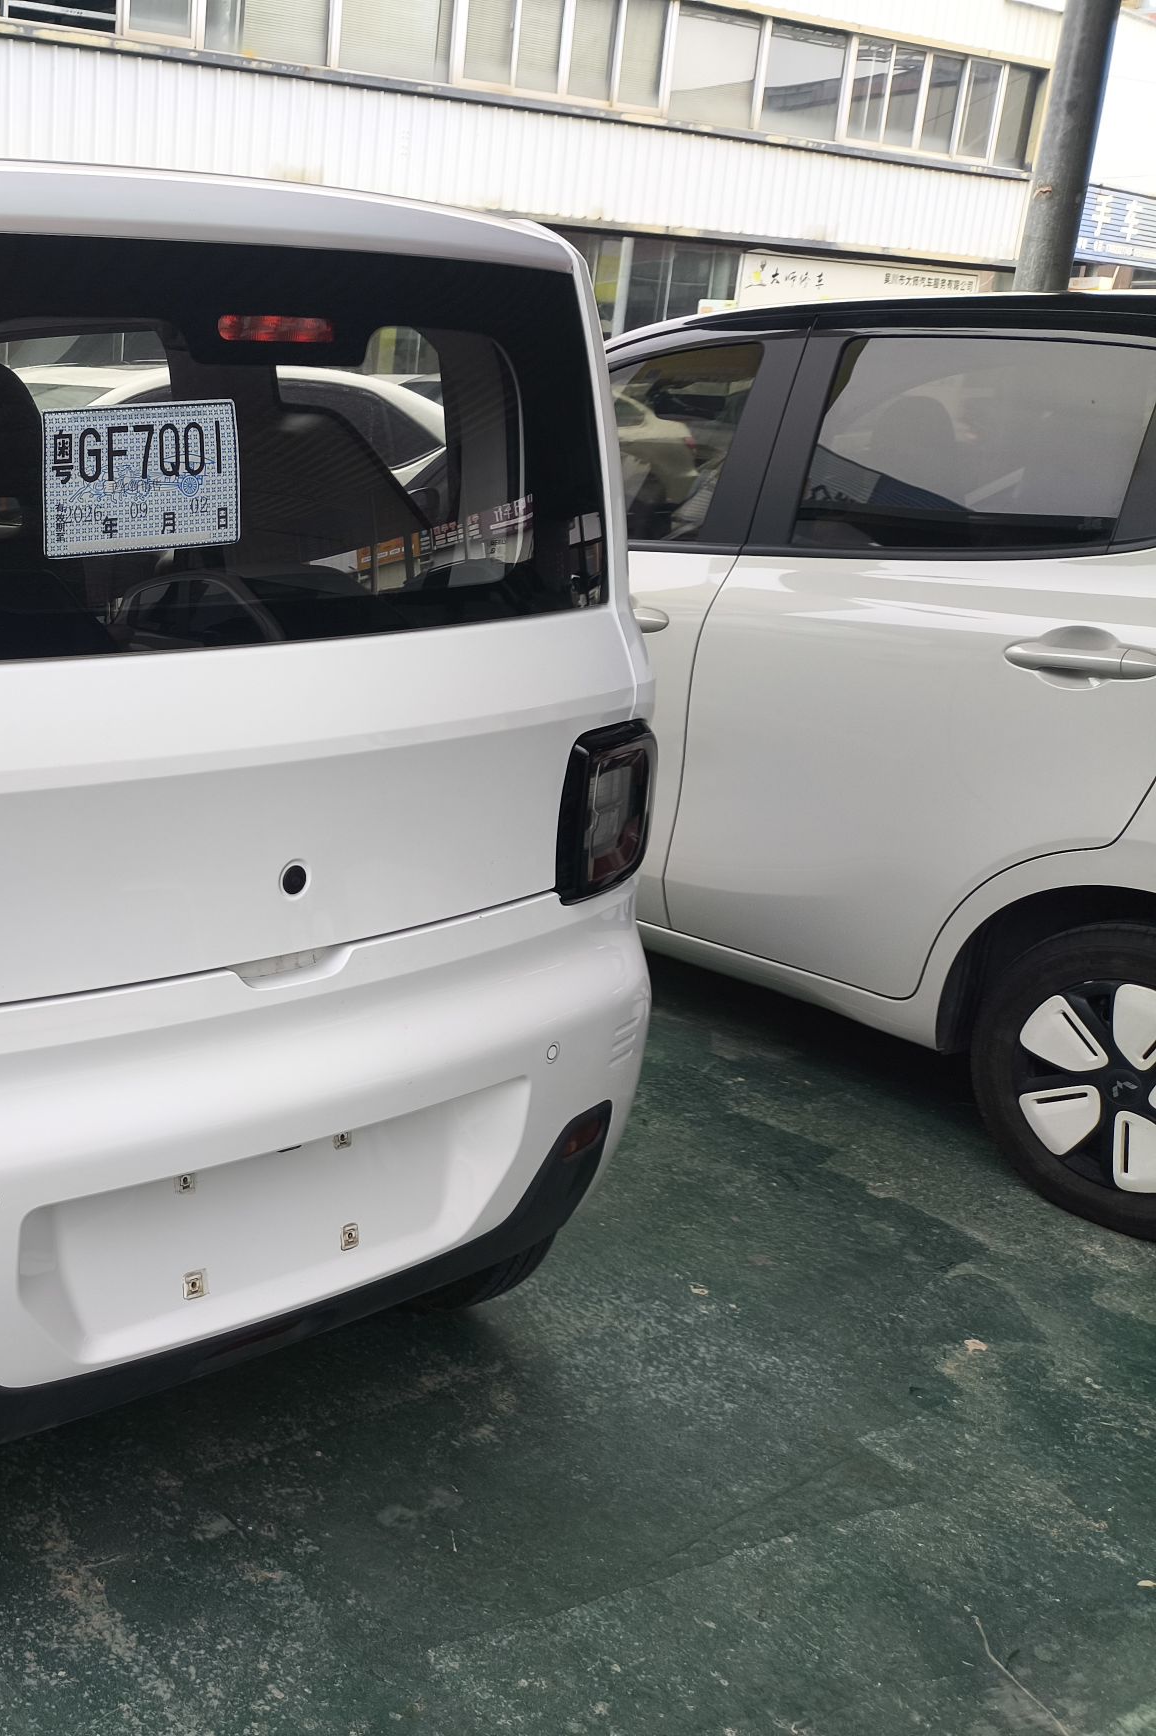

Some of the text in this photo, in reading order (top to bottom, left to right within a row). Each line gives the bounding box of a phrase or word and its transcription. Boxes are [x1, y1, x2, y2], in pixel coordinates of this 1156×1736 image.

[52, 420, 222, 484] 粤GF7Q01
[65, 505, 102, 524] 2026
[102, 516, 118, 538] 年
[130, 502, 148, 518] 09
[161, 512, 176, 534] 月
[190, 497, 208, 513] 02
[217, 507, 228, 529] 日
